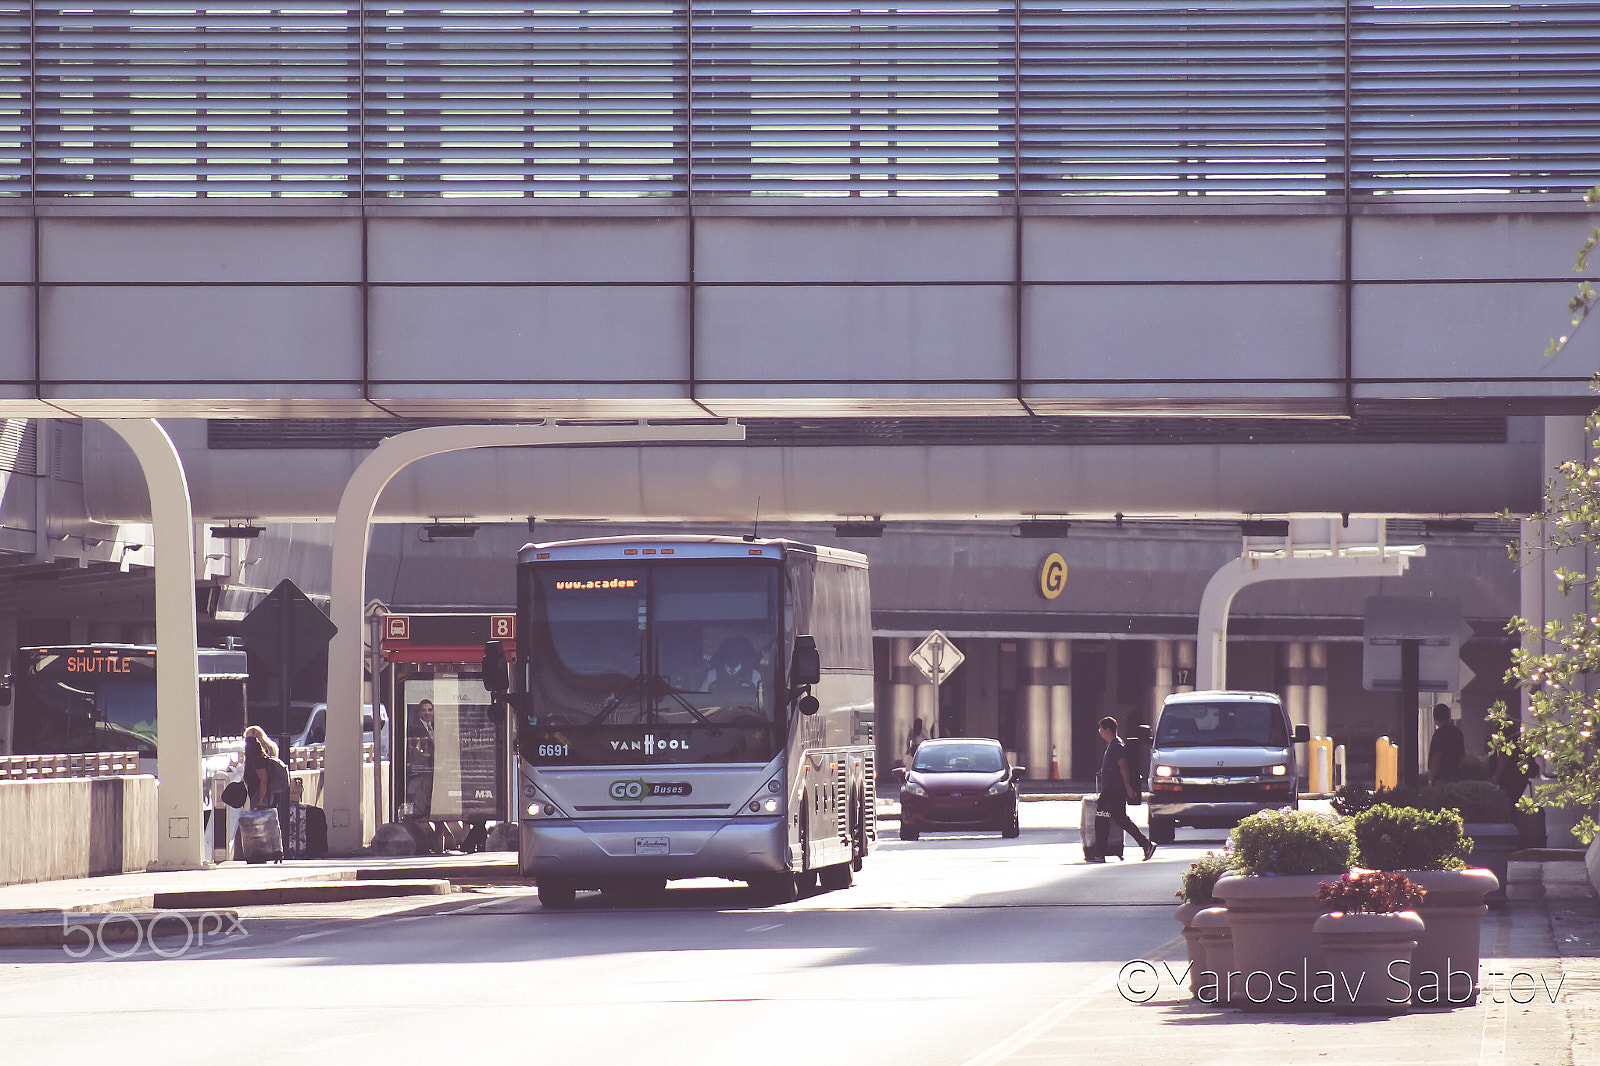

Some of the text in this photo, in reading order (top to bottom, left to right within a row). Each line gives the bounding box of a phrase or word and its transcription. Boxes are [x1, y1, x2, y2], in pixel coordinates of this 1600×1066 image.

[556, 578, 638, 590] www.academ
[1046, 561, 1063, 592] G
[497, 619, 509, 636] 8
[67, 656, 131, 673] SHUTTLE
[1177, 670, 1188, 684] 17
[538, 744, 569, 757] 6691
[611, 782, 683, 798] GO Buses
